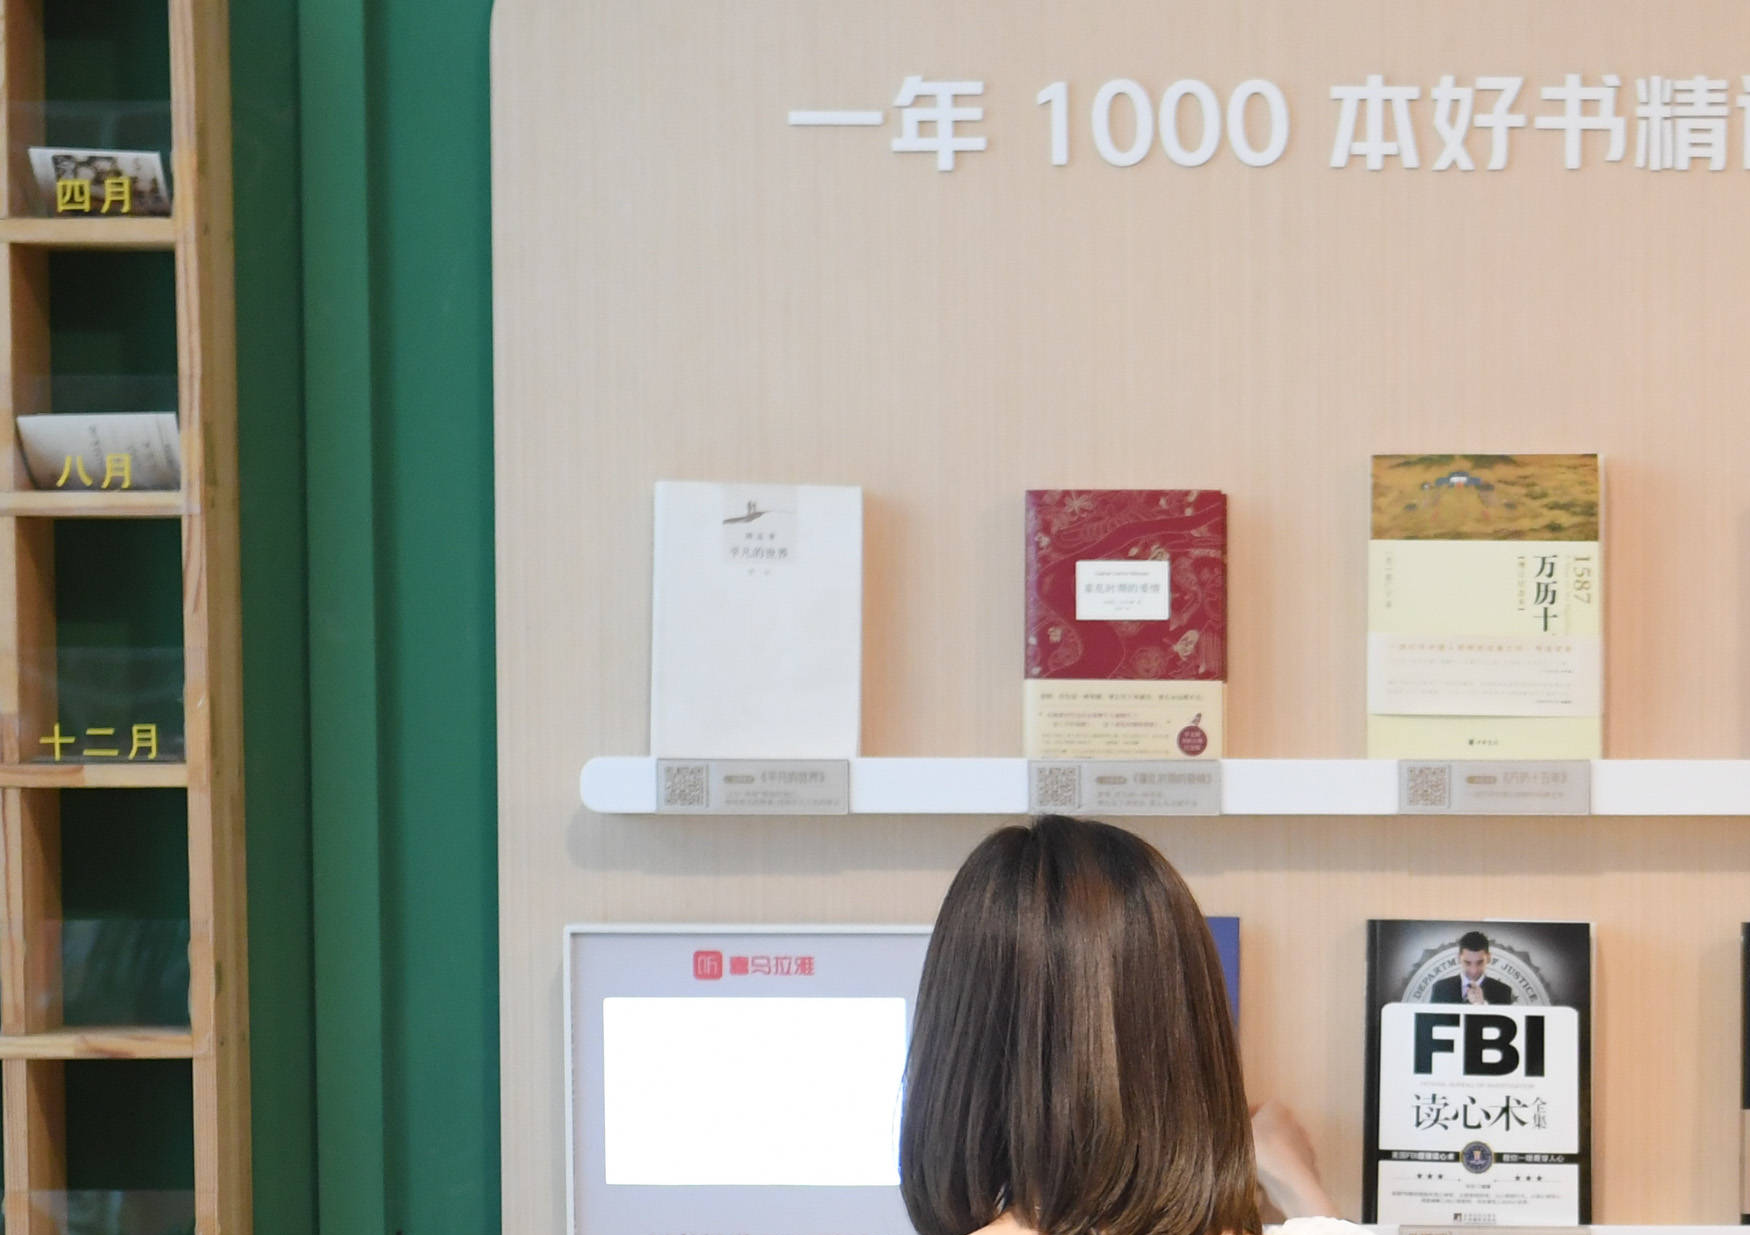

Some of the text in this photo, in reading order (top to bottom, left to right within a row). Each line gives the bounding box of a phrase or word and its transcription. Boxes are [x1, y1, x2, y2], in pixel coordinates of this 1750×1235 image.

[787, 75, 988, 172] 一年
[1034, 78, 1290, 169] 1000
[56, 176, 131, 213] 四月
[56, 453, 131, 489] 八月
[1573, 555, 1592, 605] 1587
[39, 722, 157, 761] 十二月
[1413, 958, 1457, 1000] DEPARTM
[1500, 963, 1539, 1002] JUSTICE
[1413, 1012, 1546, 1078] FBI
[1412, 1093, 1529, 1132] 读心术
